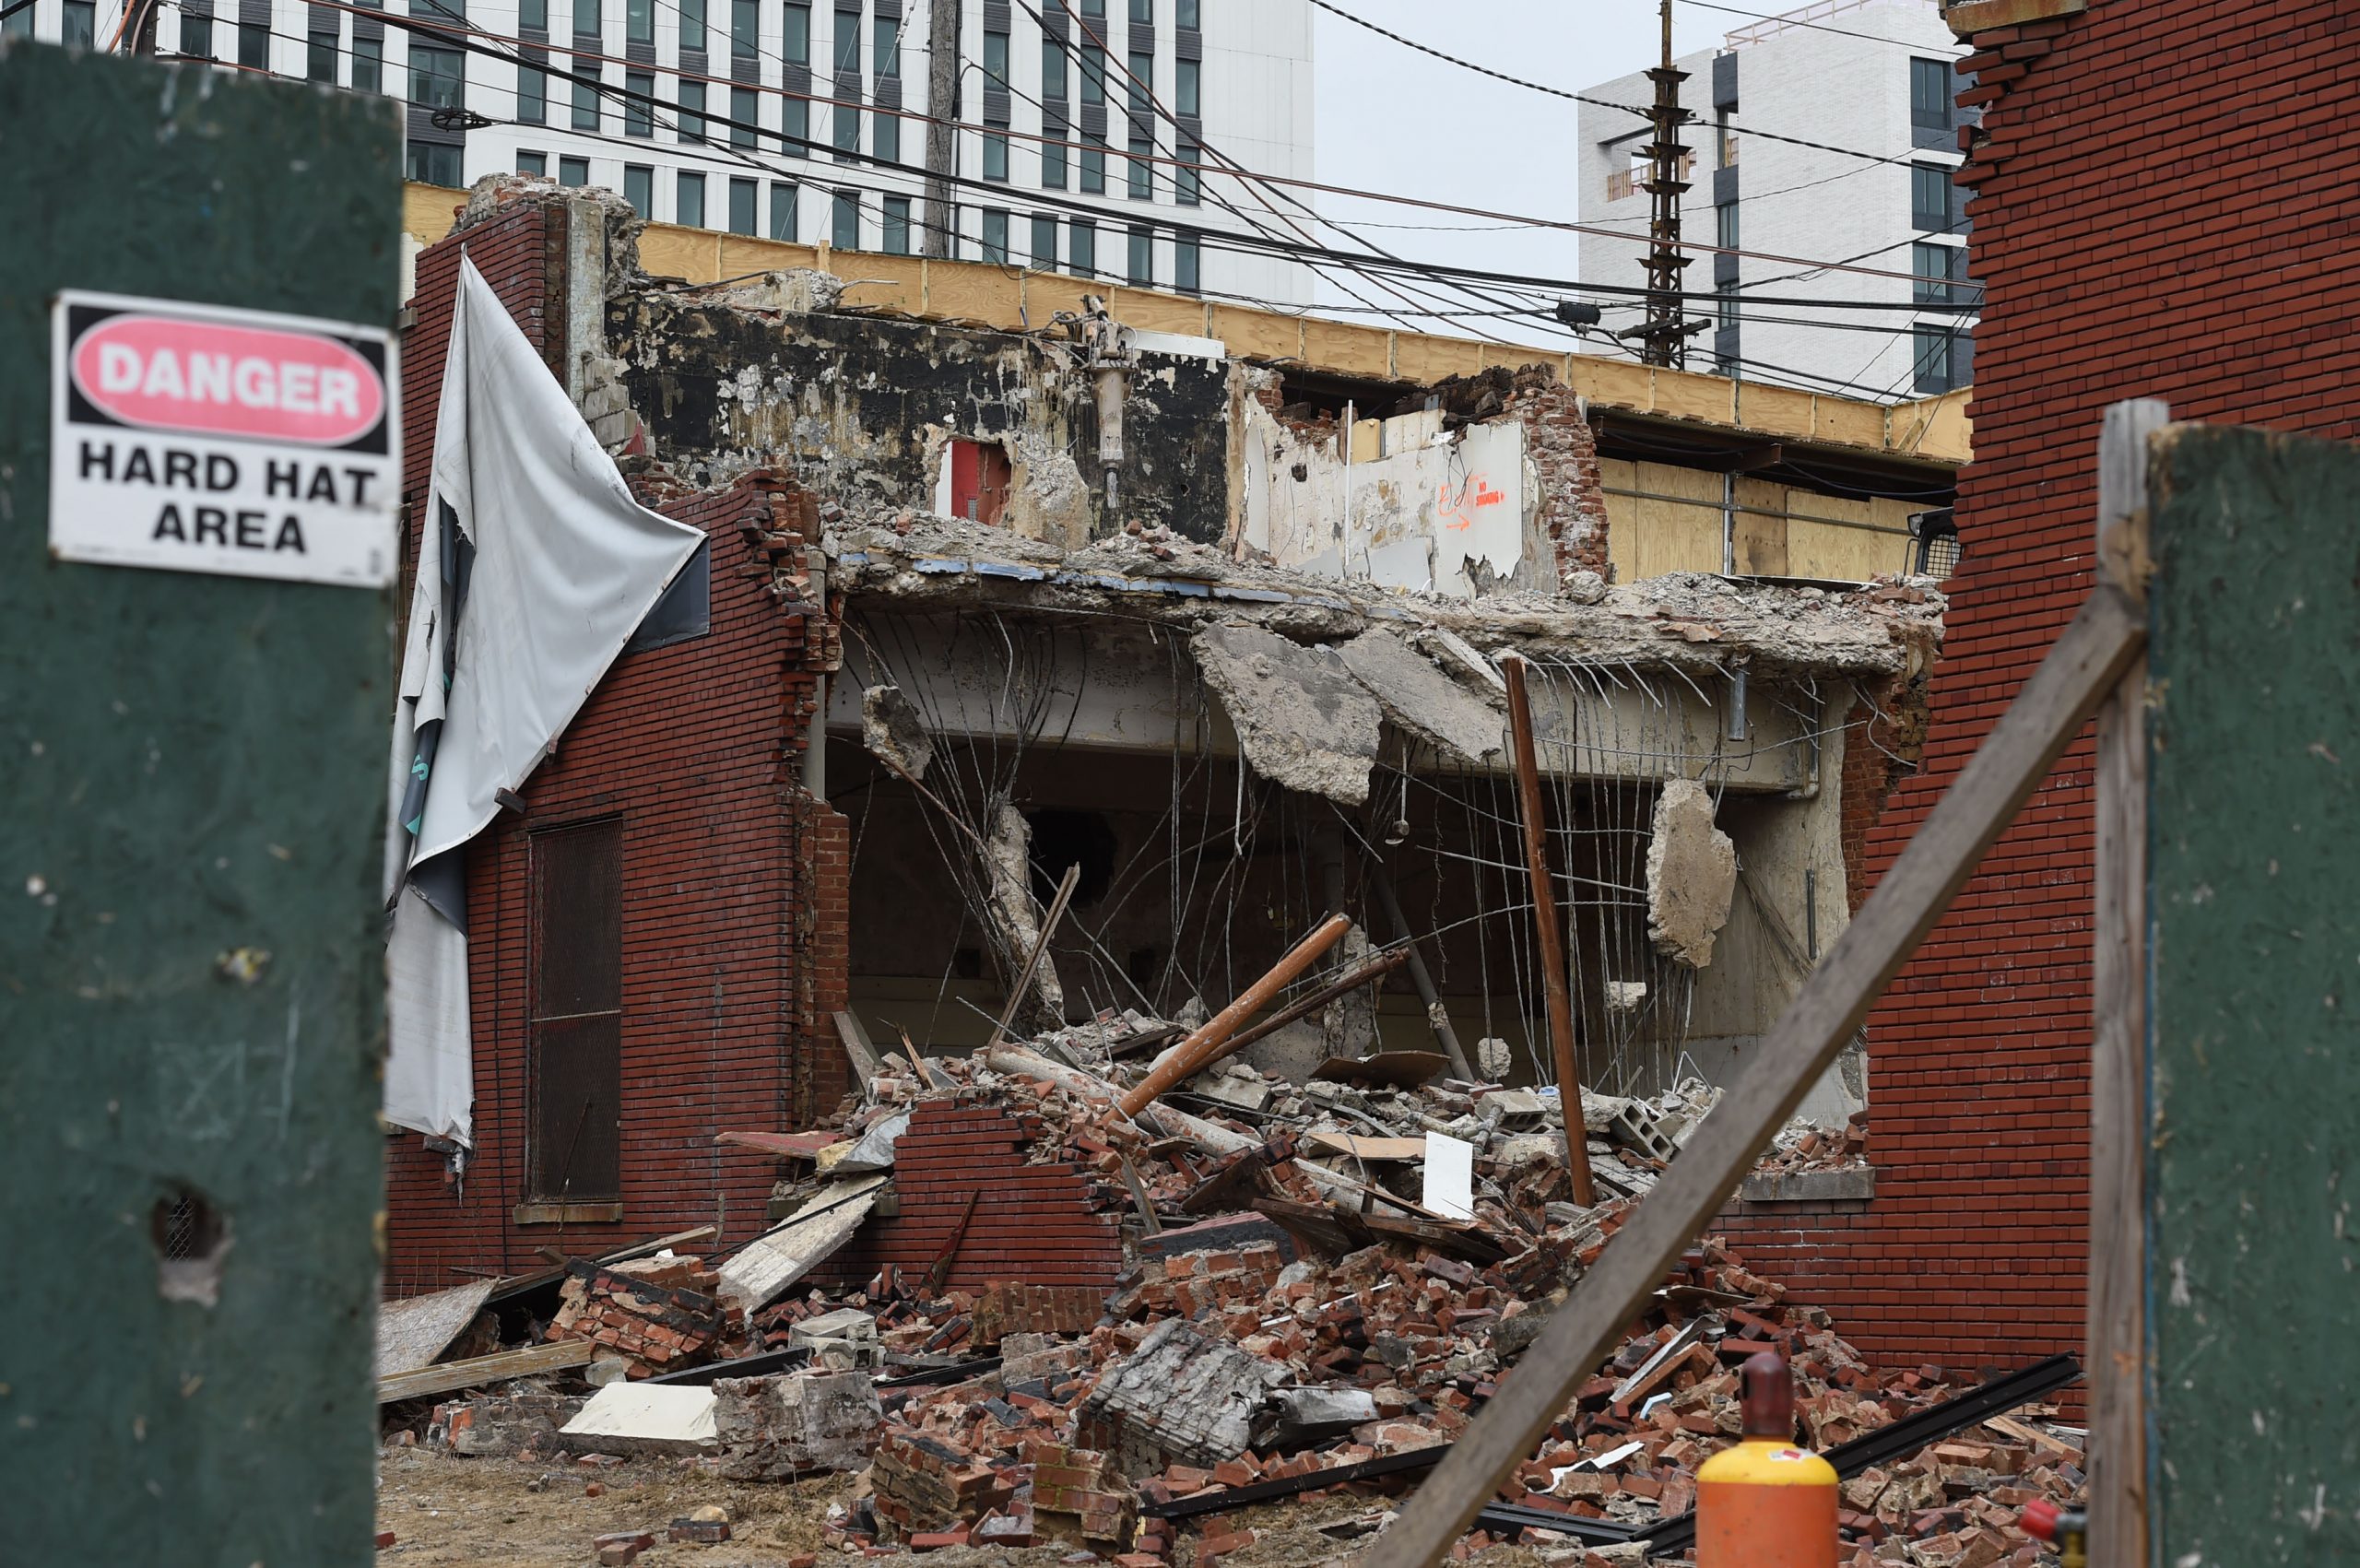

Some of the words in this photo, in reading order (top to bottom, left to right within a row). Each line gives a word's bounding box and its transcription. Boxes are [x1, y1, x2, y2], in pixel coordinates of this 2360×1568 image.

[98, 342, 360, 419] DANGER
[78, 440, 239, 492] HARD
[266, 459, 376, 507] HAT
[1479, 481, 1487, 493] NO
[152, 503, 307, 555] AREA
